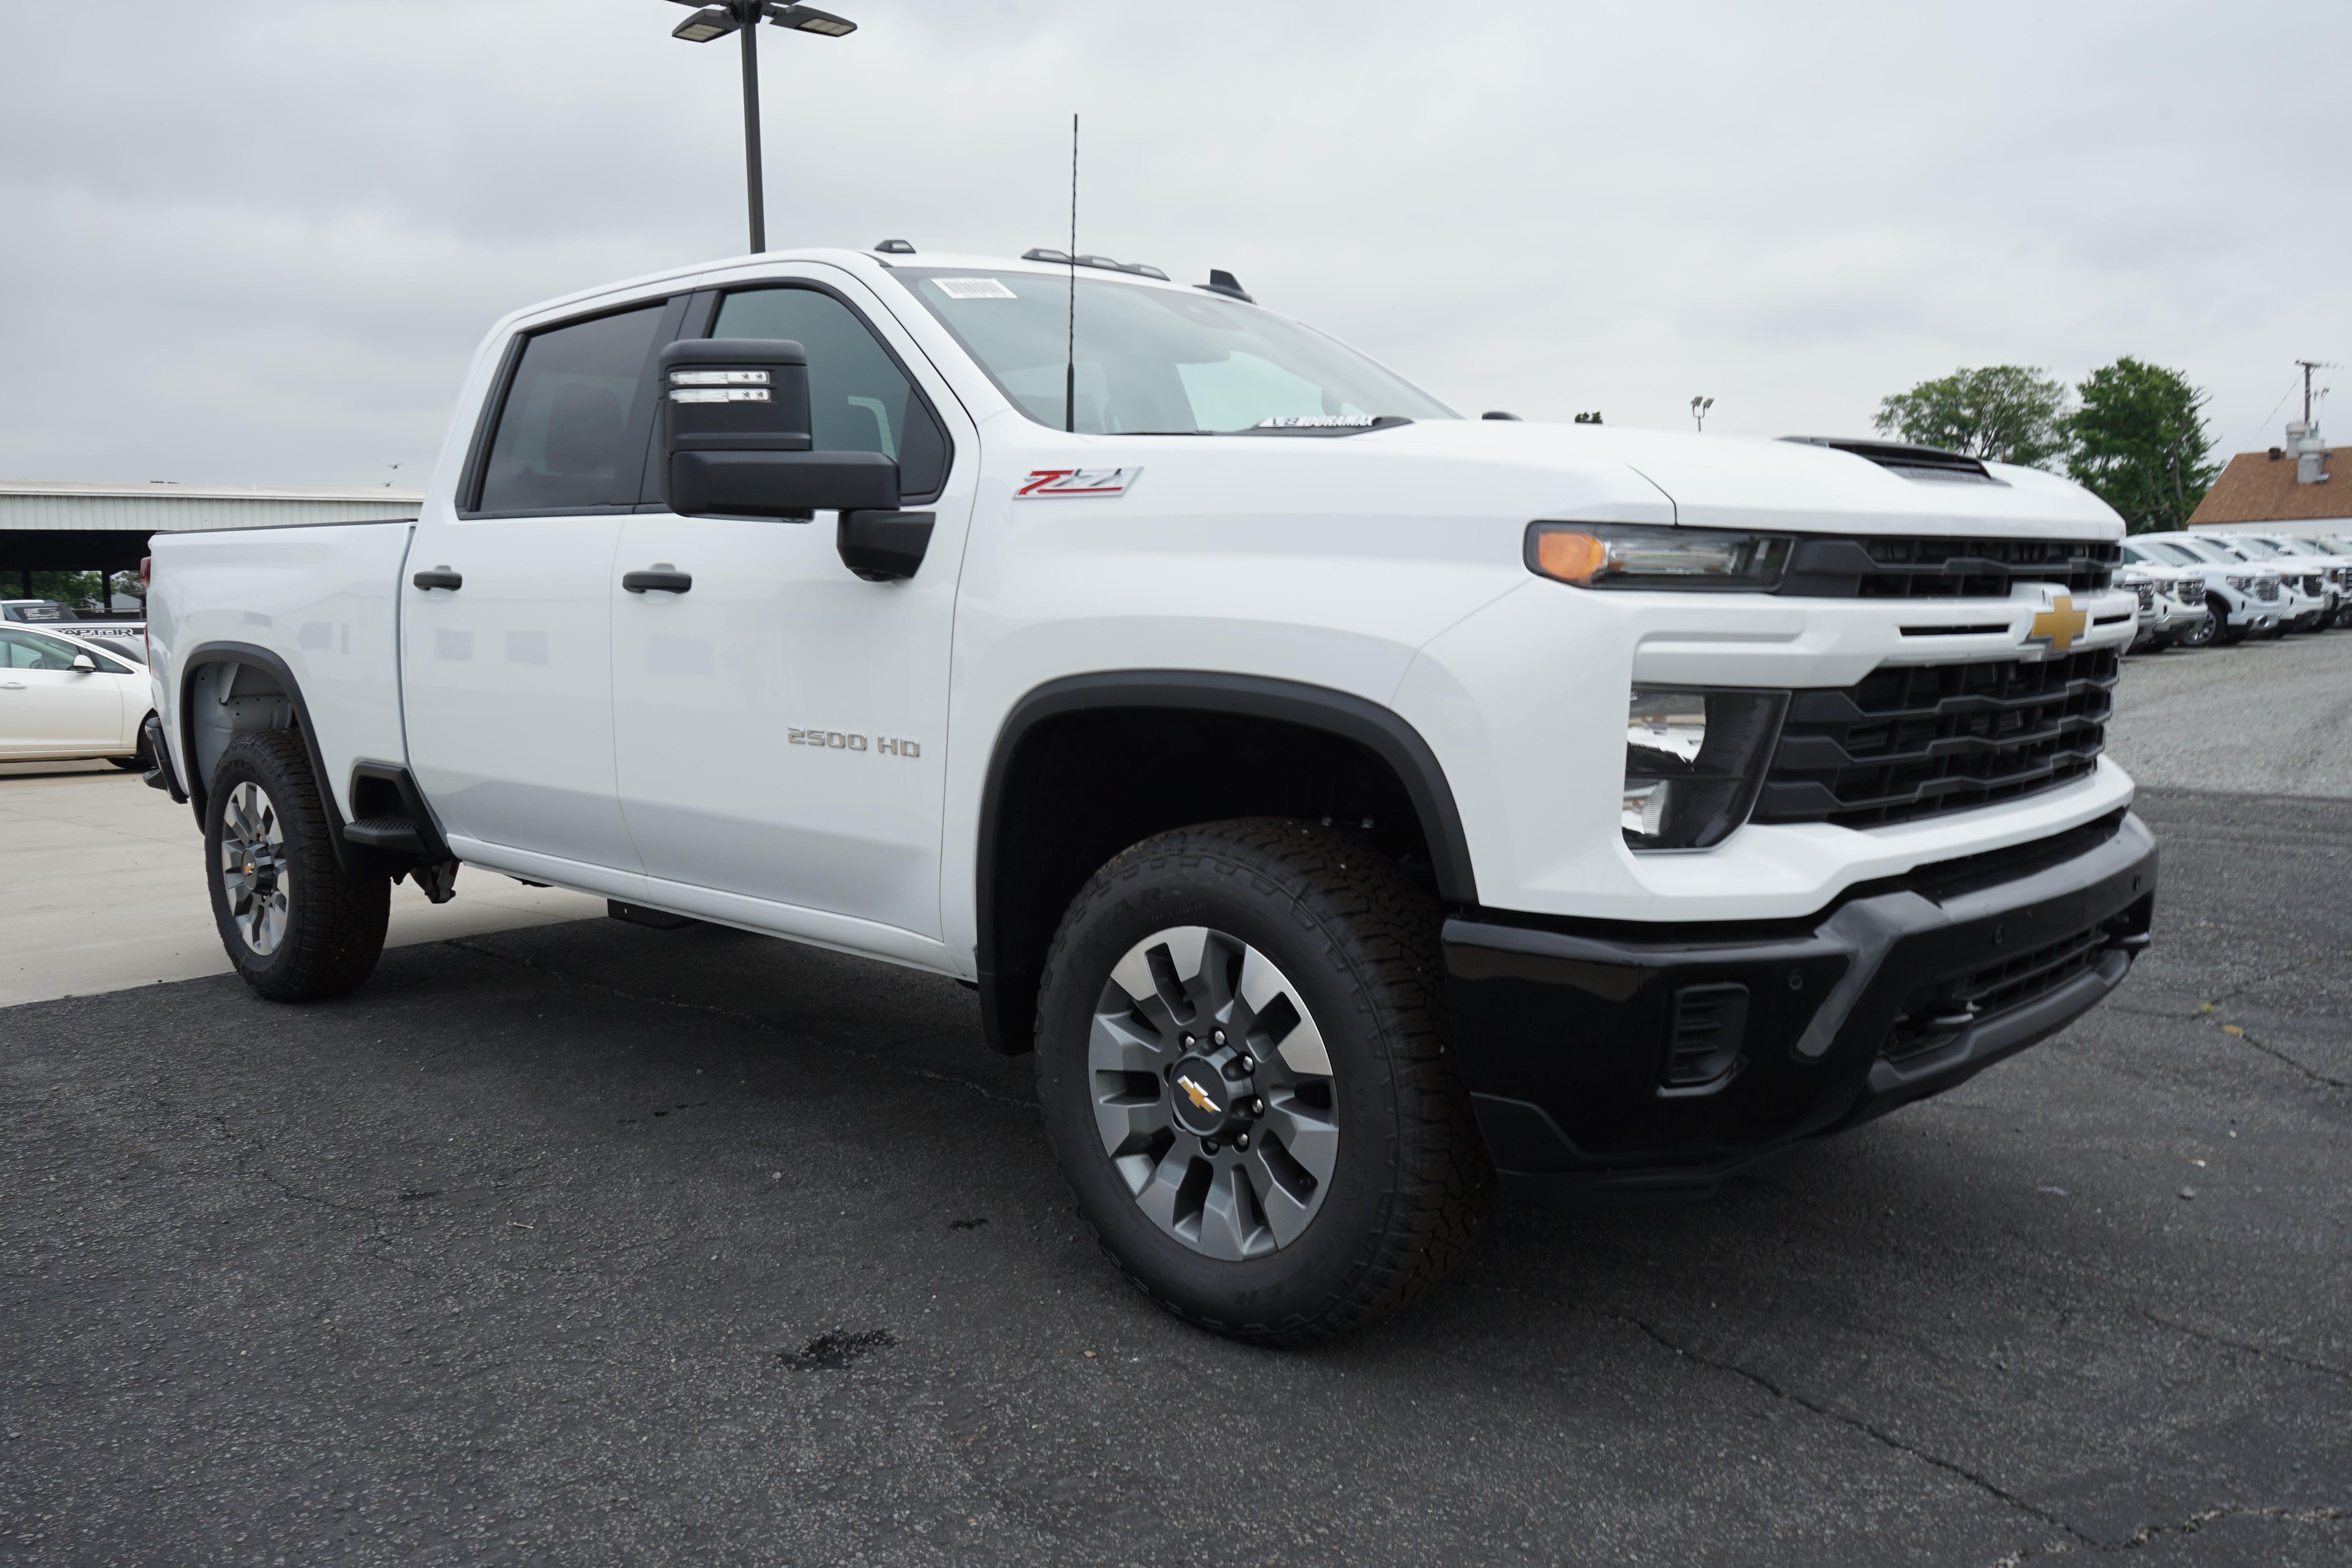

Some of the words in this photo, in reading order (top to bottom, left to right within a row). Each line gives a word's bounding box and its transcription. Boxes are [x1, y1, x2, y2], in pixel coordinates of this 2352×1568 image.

[1013, 467, 1143, 499] Z71
[53, 628, 139, 641] APTOR
[788, 726, 867, 751] 2500
[878, 736, 920, 757] HD
